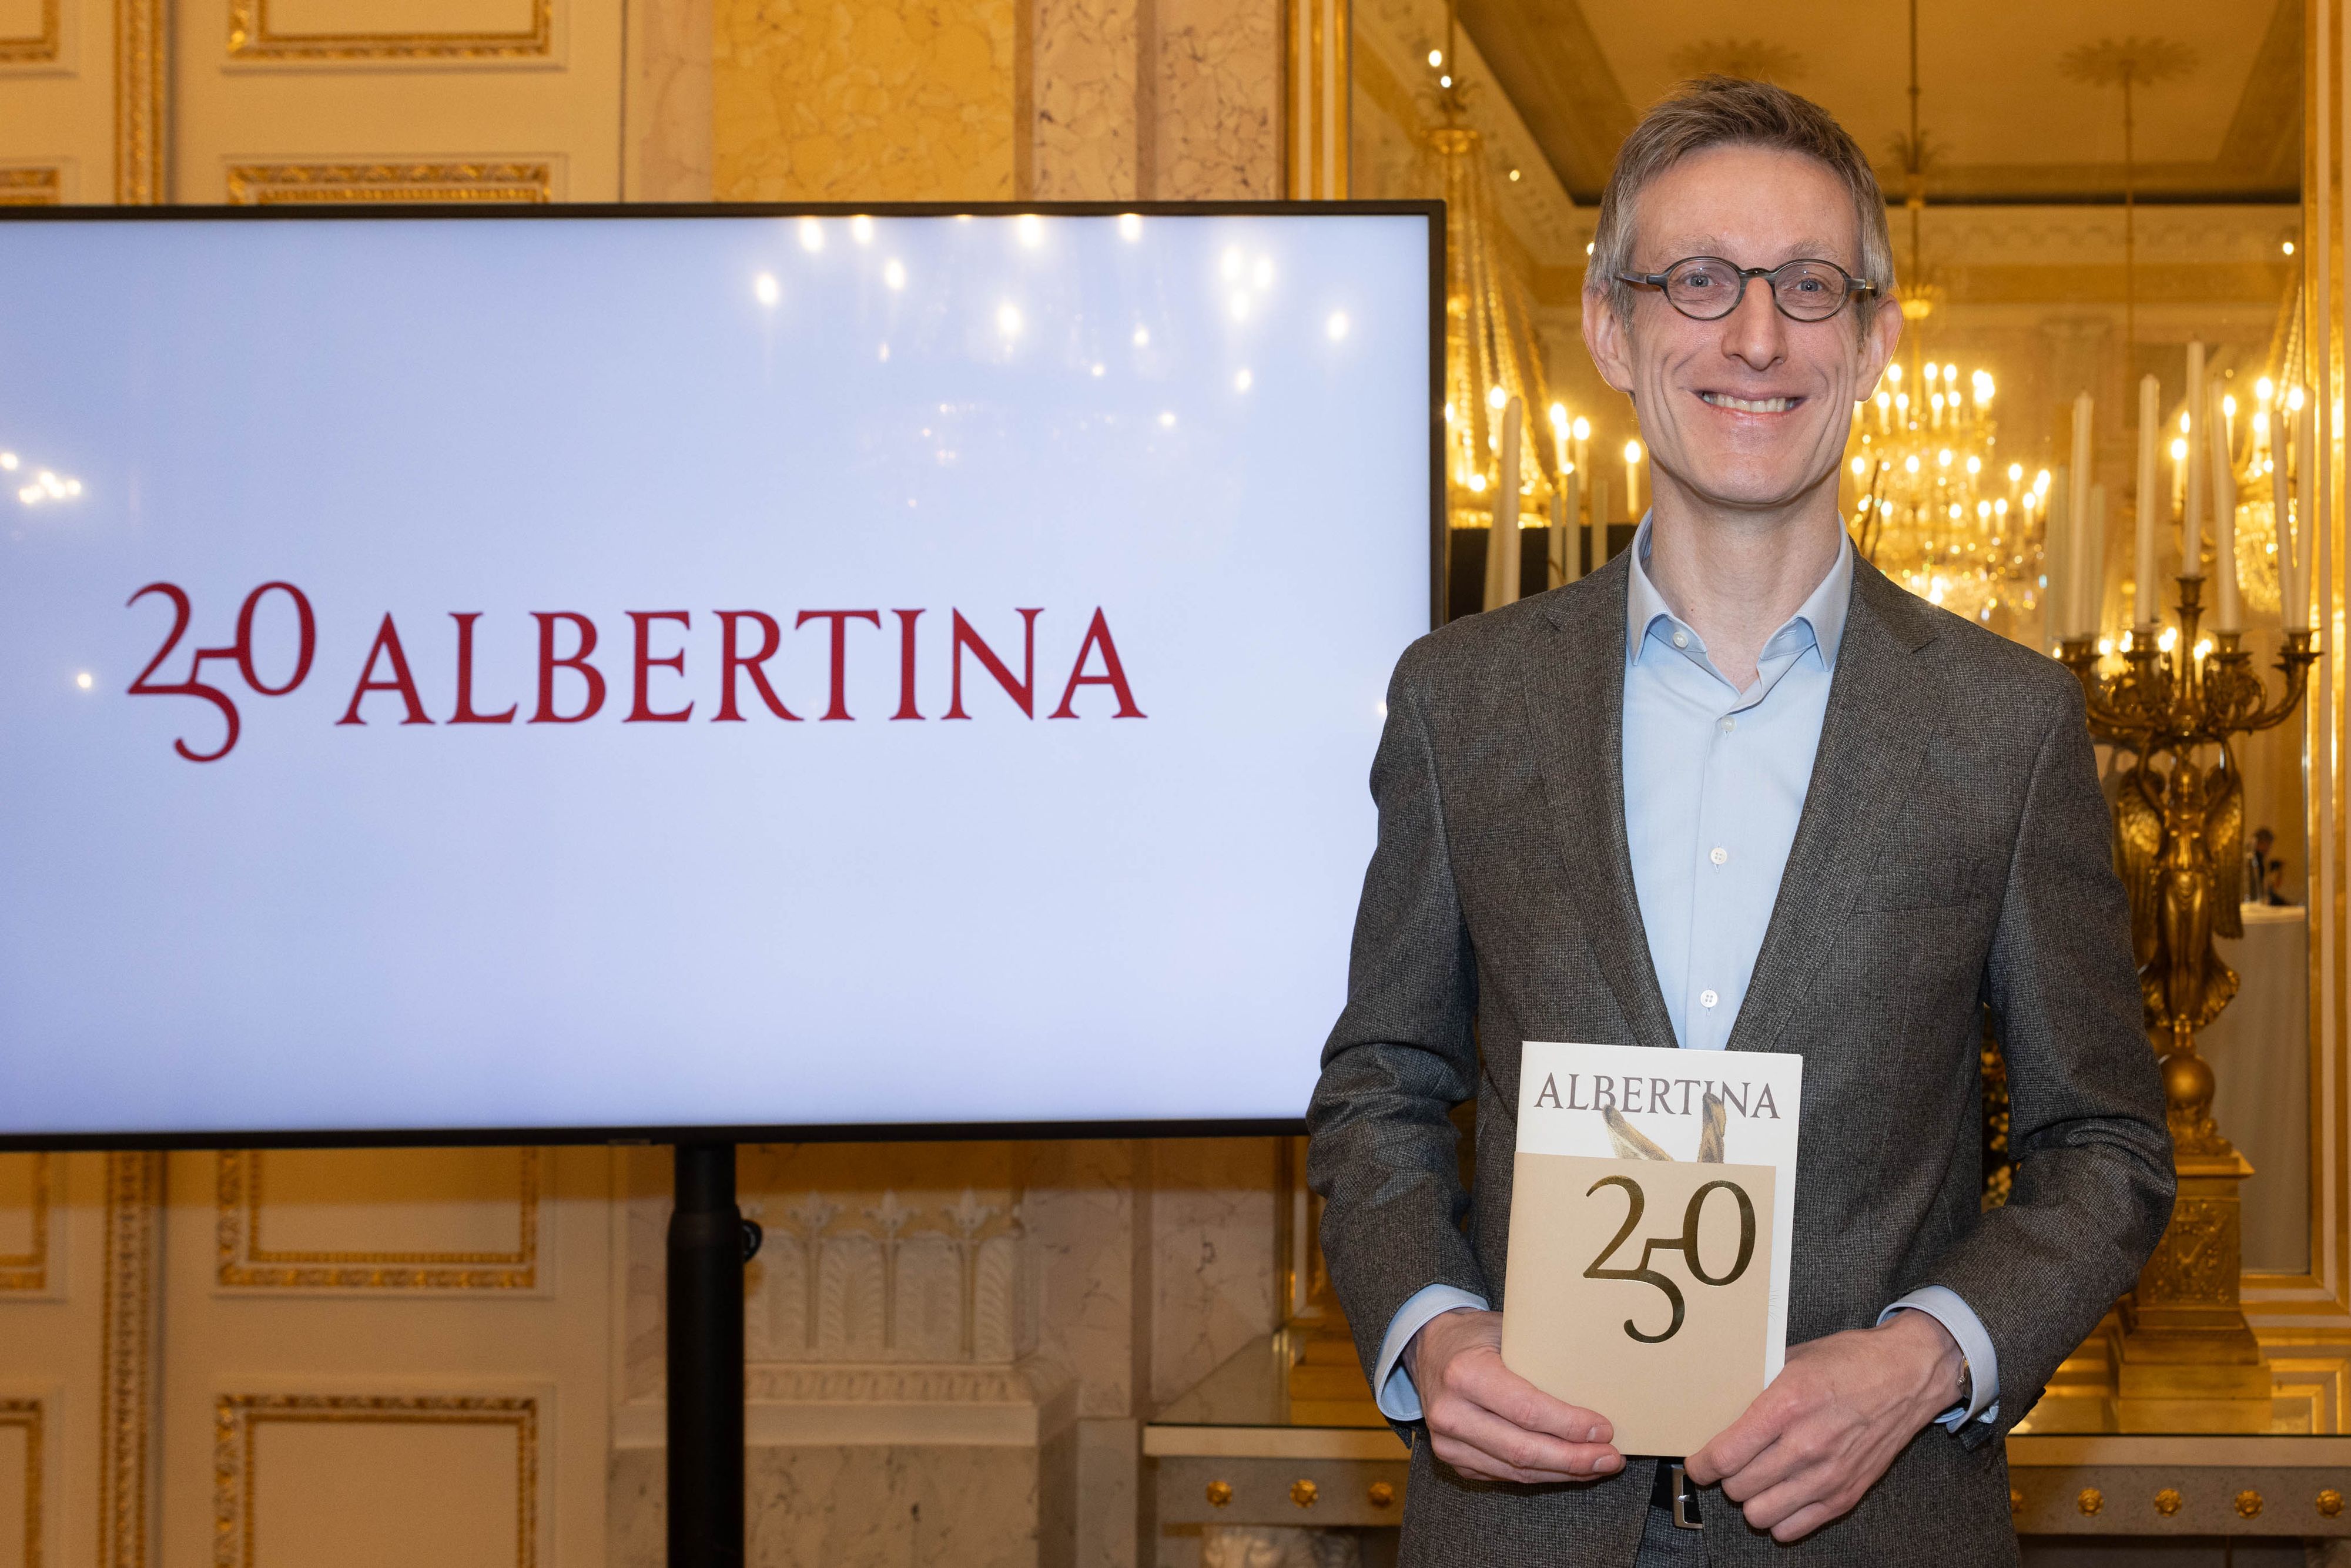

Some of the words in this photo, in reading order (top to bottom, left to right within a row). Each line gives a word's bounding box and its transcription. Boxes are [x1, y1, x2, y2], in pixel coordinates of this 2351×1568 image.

[126, 581, 316, 763] 250
[335, 606, 1147, 725] ALBERTINA
[1582, 1174, 1757, 1344] 250
